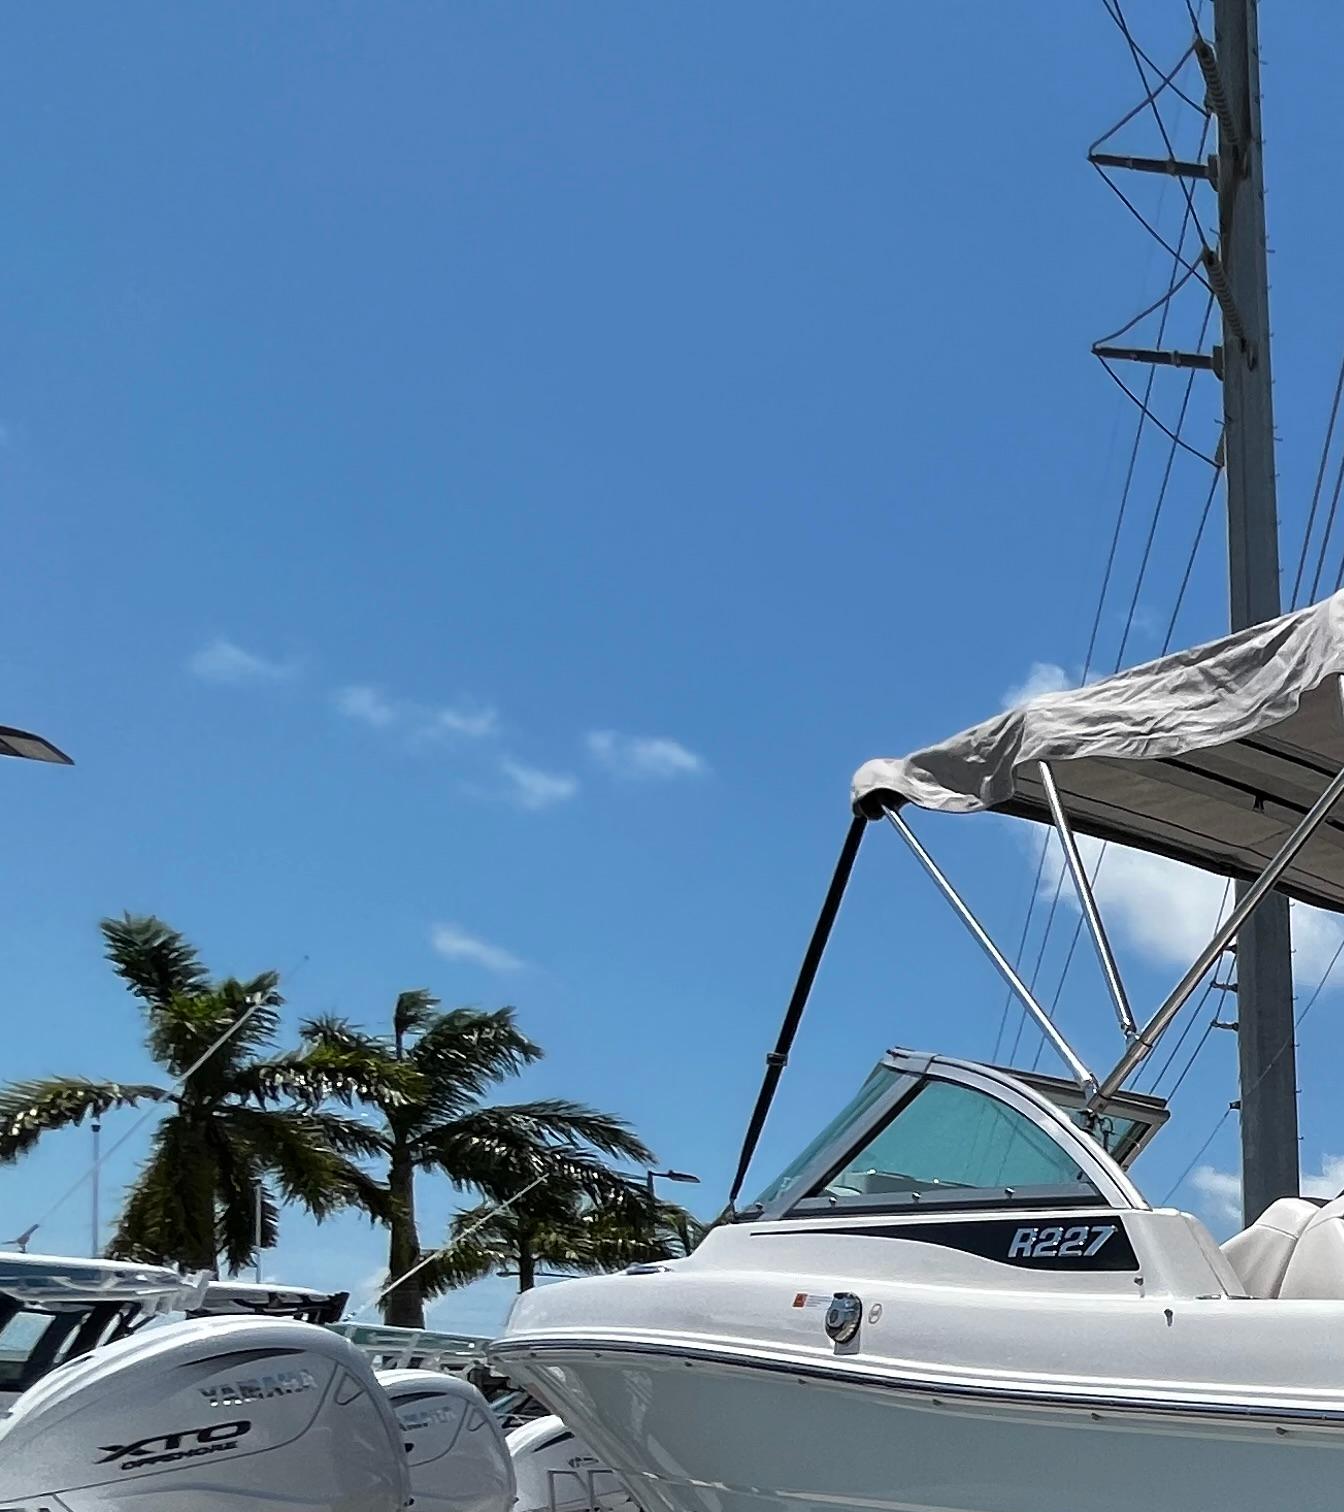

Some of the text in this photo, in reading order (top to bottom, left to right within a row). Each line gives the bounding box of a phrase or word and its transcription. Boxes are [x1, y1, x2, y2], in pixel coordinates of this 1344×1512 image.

[1007, 1225, 1118, 1258] R227
[199, 1370, 317, 1407] YAMAHA
[93, 1420, 252, 1464] XTO
